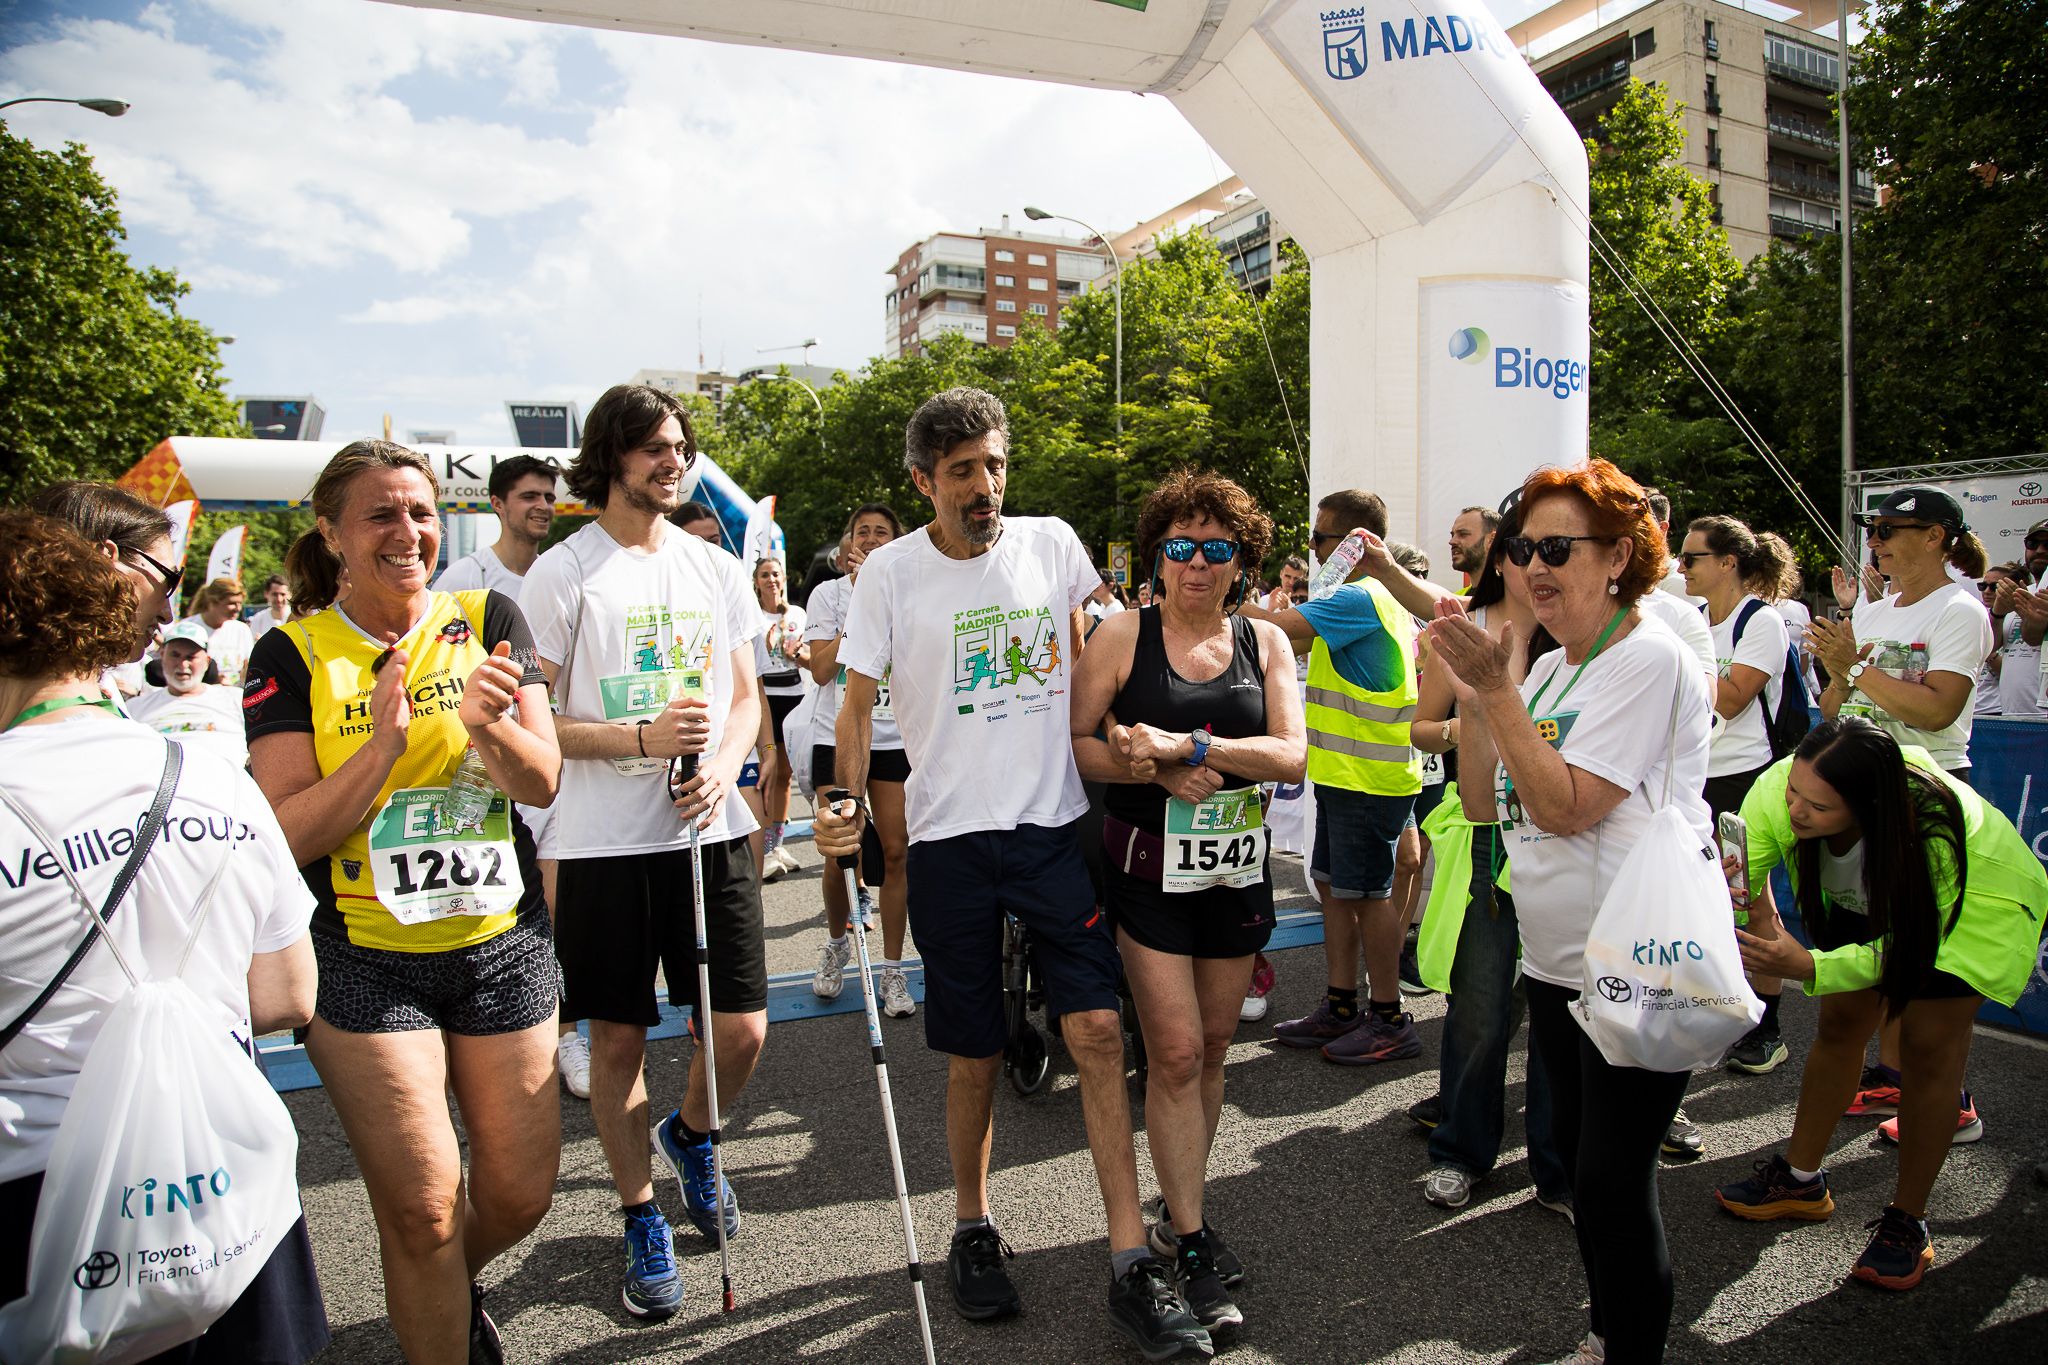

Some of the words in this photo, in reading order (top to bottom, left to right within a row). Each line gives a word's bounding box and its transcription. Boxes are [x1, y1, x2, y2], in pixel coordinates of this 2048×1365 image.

[1381, 15, 1507, 62] MADR
[1495, 347, 1587, 399] Biogen
[513, 407, 565, 418] REALIA
[1970, 494, 1998, 503] Biogen
[954, 613, 1005, 633] MADRID
[1008, 609, 1034, 621] CON
[1036, 606, 1051, 617] LA
[966, 605, 1000, 618] Carrera
[954, 616, 1062, 683] ELA
[339, 722, 375, 737] Insp
[410, 705, 434, 719] he
[438, 698, 461, 712] Ne
[407, 793, 446, 803] MADRID
[403, 802, 486, 840] ELA
[1190, 800, 1248, 830] ELA
[1177, 835, 1257, 871] 1542
[389, 846, 507, 896] 1282
[1641, 997, 1689, 1011] Financial
[1692, 993, 1742, 1008] Services
[138, 1244, 197, 1266] Toyota
[138, 1252, 219, 1285] Financial
